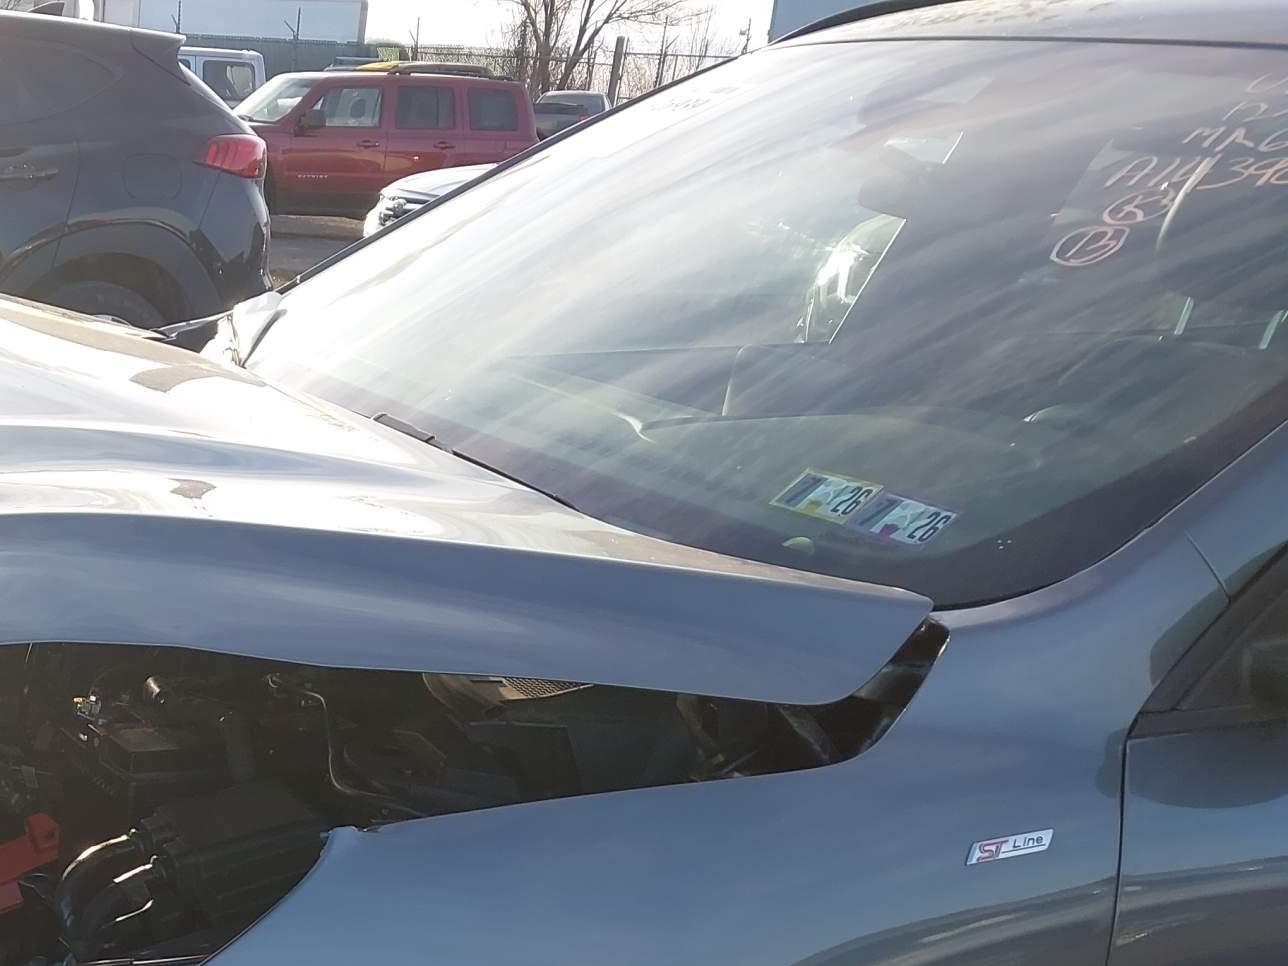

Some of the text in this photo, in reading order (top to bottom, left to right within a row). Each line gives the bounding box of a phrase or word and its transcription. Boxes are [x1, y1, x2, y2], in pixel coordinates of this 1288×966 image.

[830, 486, 874, 516] 26
[907, 511, 952, 543] 26
[977, 835, 1044, 863] ST Line
